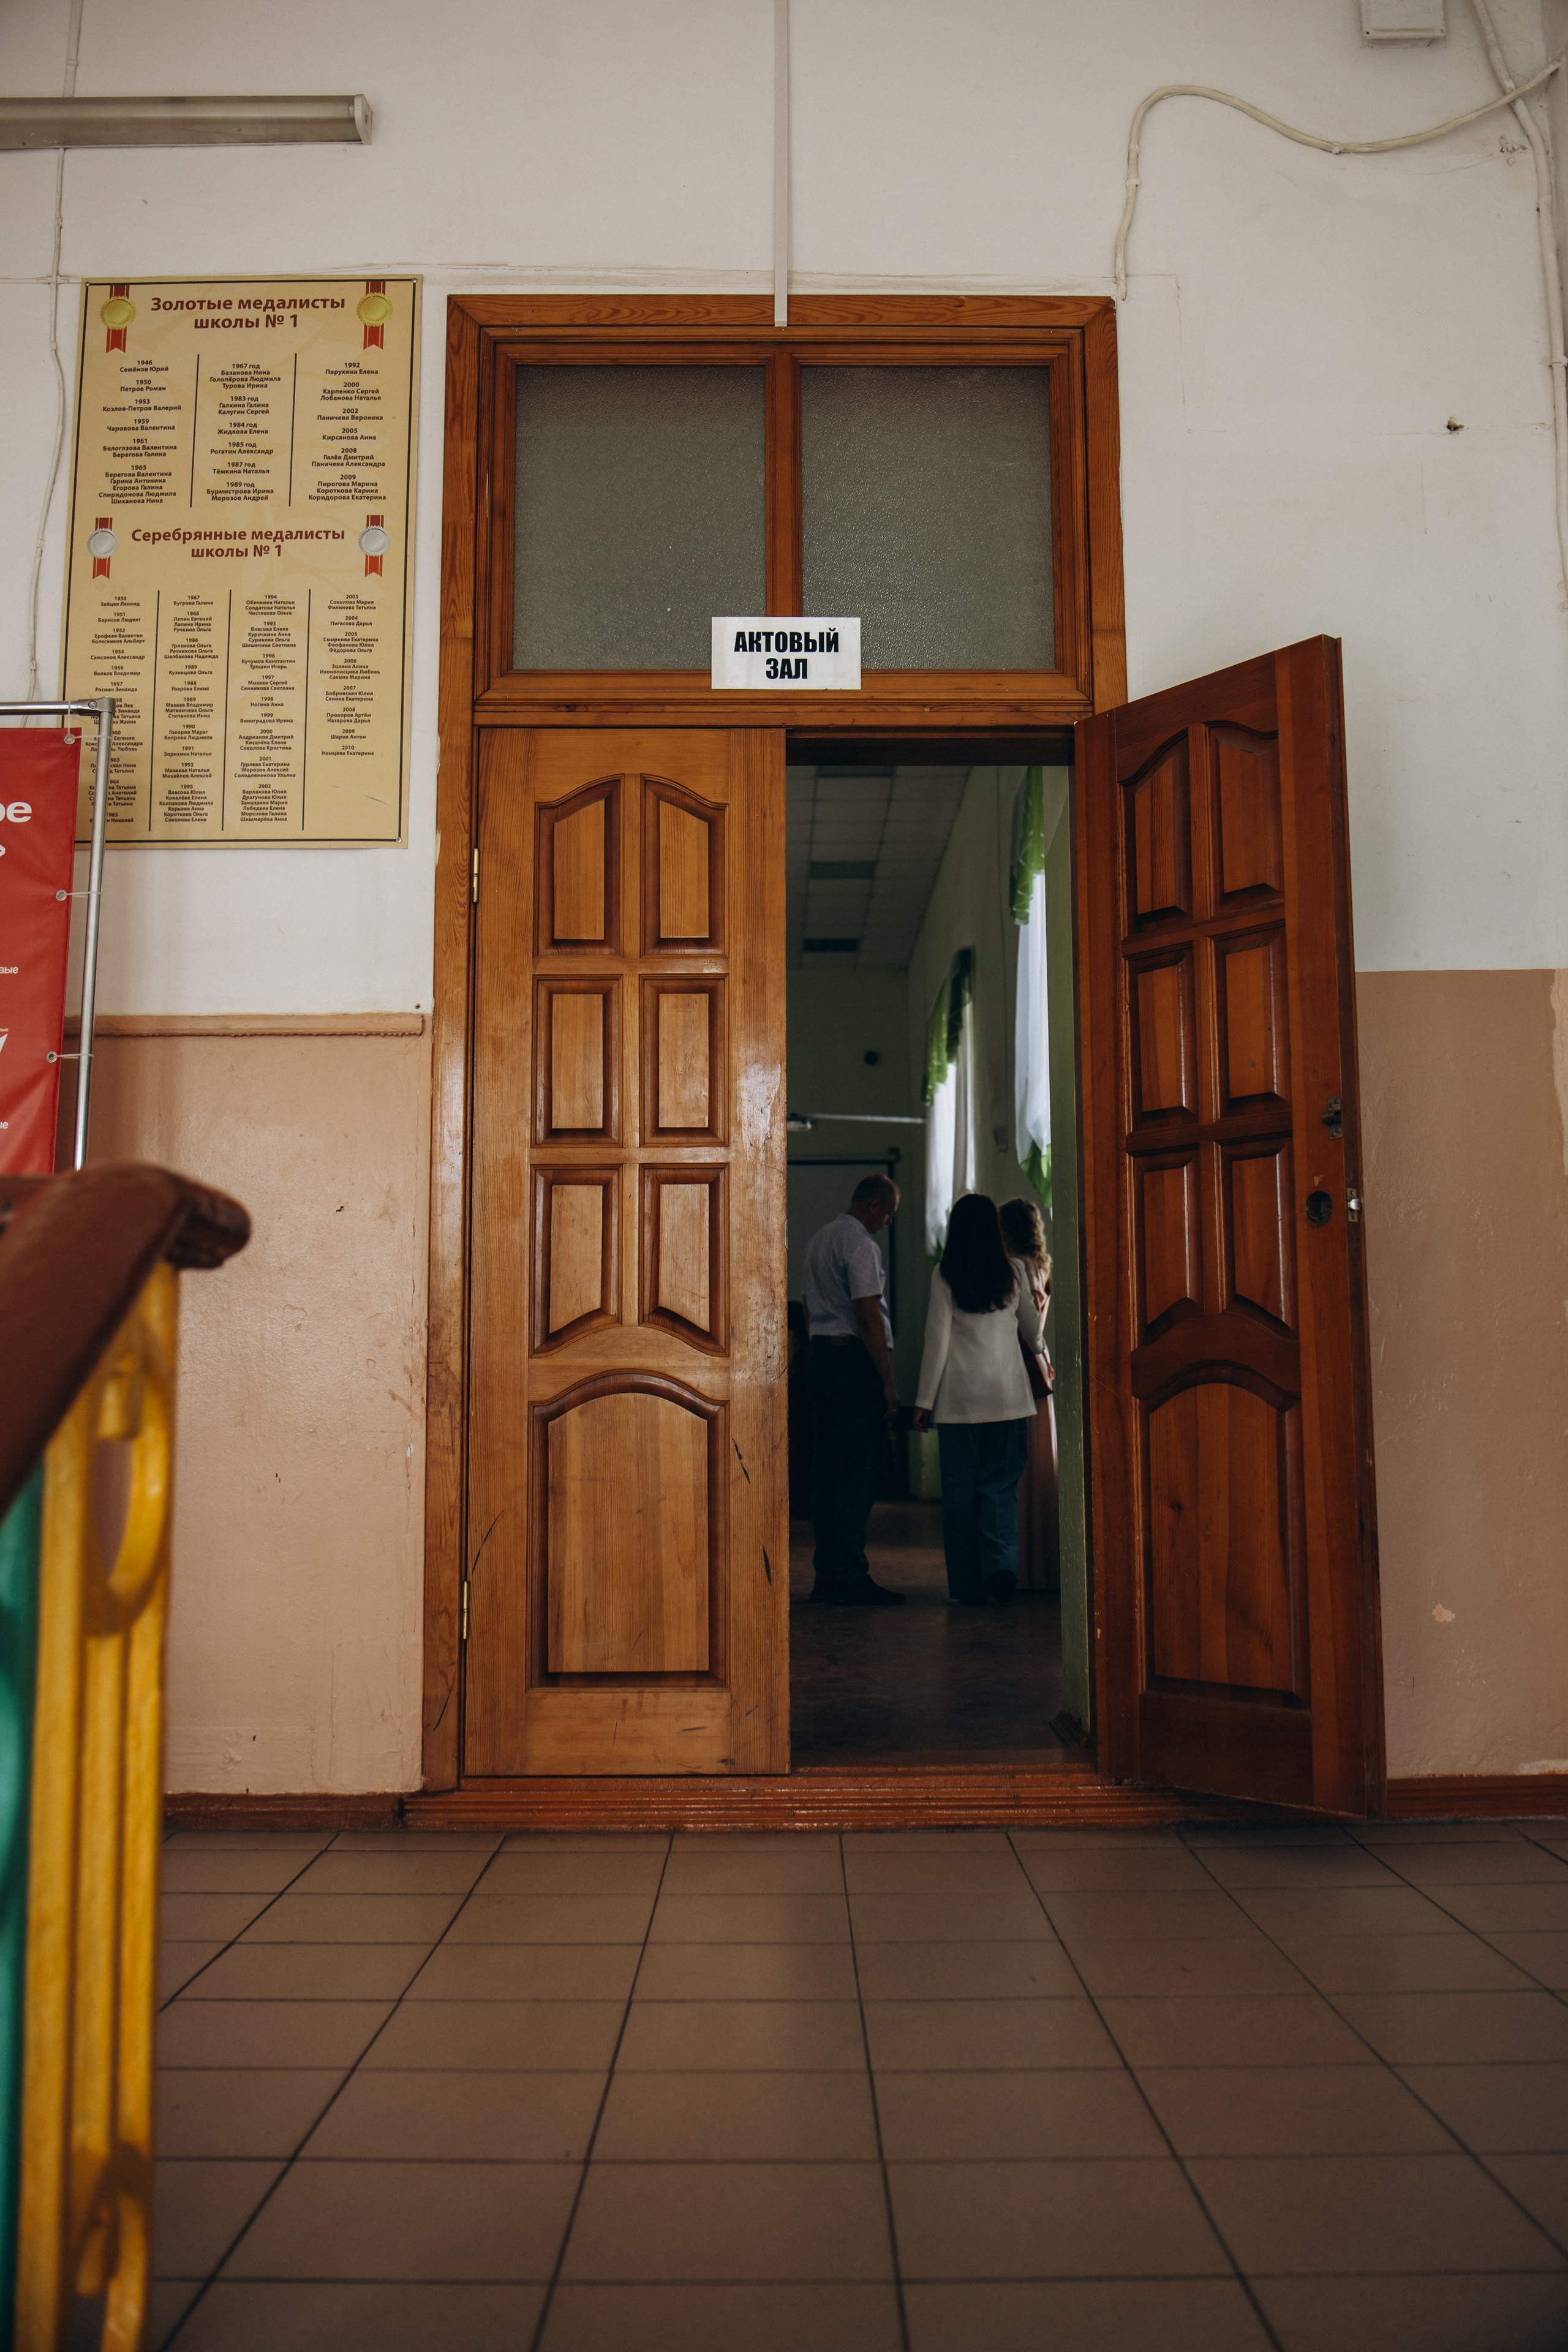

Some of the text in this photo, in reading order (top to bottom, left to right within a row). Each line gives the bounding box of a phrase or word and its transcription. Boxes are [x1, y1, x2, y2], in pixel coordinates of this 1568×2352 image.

[151, 298, 345, 312] Золотые медалисты
[194, 314, 298, 329] школы № 1
[99, 490, 144, 499] Спиридонова
[132, 528, 345, 545] Серебрянные медалисты
[191, 545, 282, 557] школы № 1
[734, 627, 839, 653] АКТОВЫЙ
[766, 658, 808, 679] ЗАЛ
